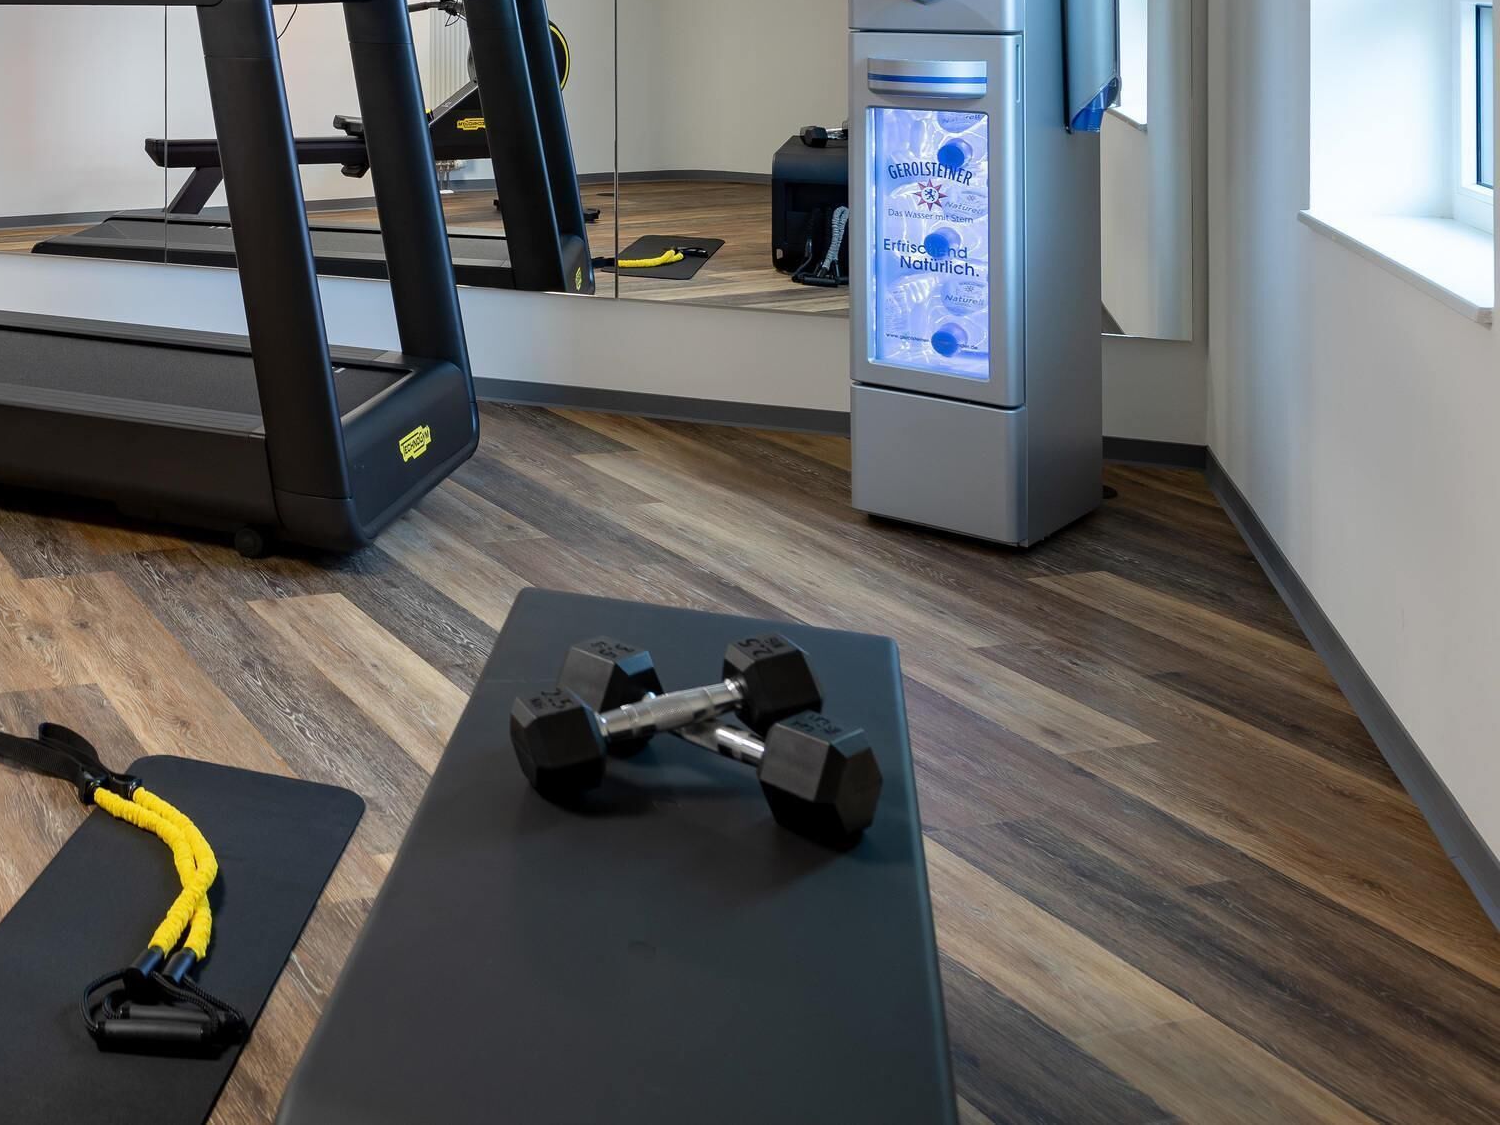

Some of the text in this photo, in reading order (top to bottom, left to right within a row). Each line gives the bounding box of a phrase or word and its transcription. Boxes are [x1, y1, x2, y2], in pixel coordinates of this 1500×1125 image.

[888, 161, 973, 186] GEROLSTEINER
[888, 208, 974, 224] Das Wasser mit Stern
[883, 238, 968, 259] Erfriscnd
[900, 255, 980, 277] Natürlich.
